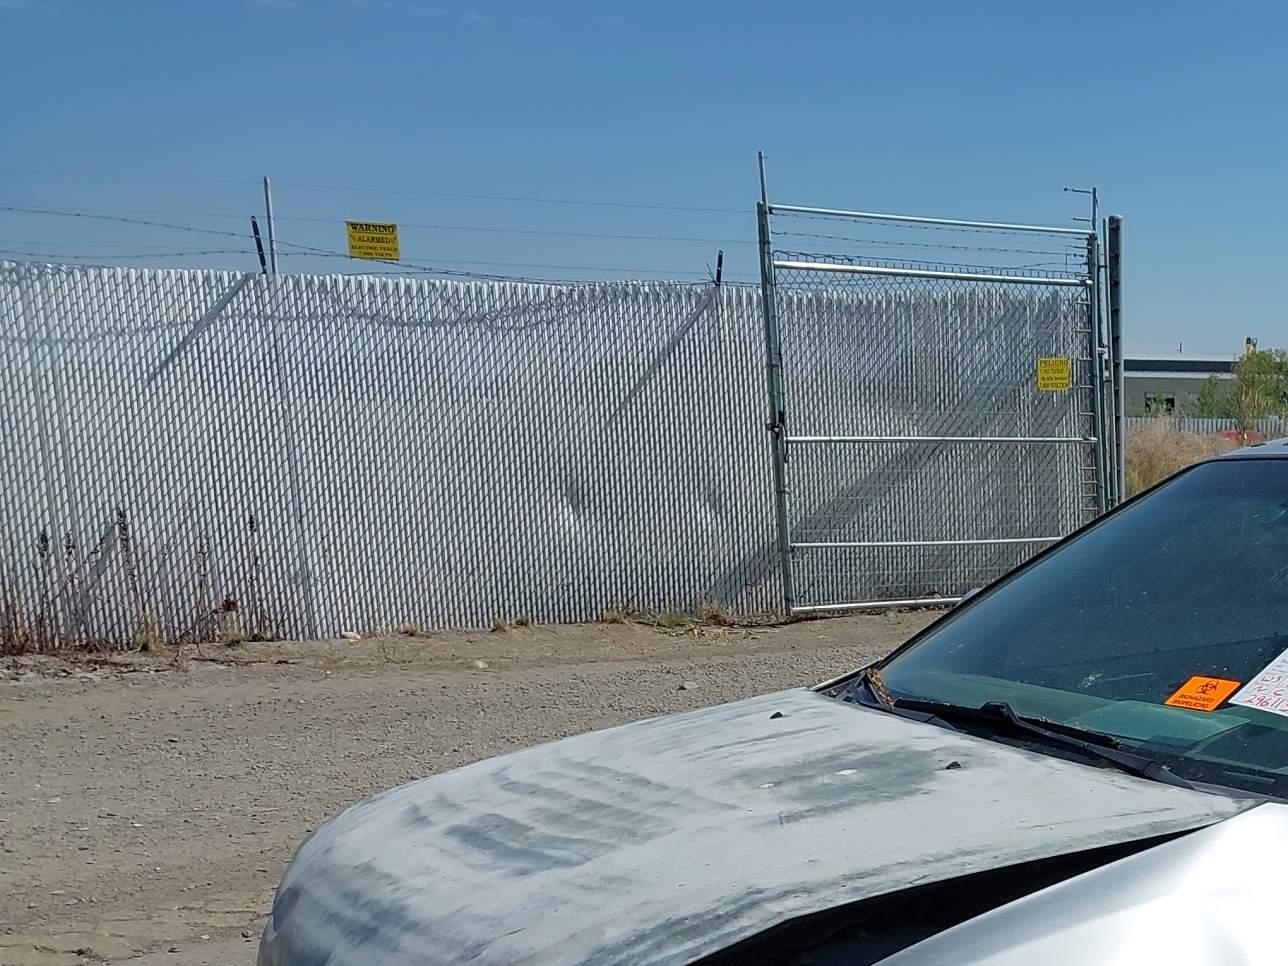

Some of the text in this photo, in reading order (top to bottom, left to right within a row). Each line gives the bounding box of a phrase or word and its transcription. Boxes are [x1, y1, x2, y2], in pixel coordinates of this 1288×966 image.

[351, 223, 394, 233] WARNING
[358, 235, 391, 244] ALARMED
[1178, 693, 1216, 703] BIOHAZARD
